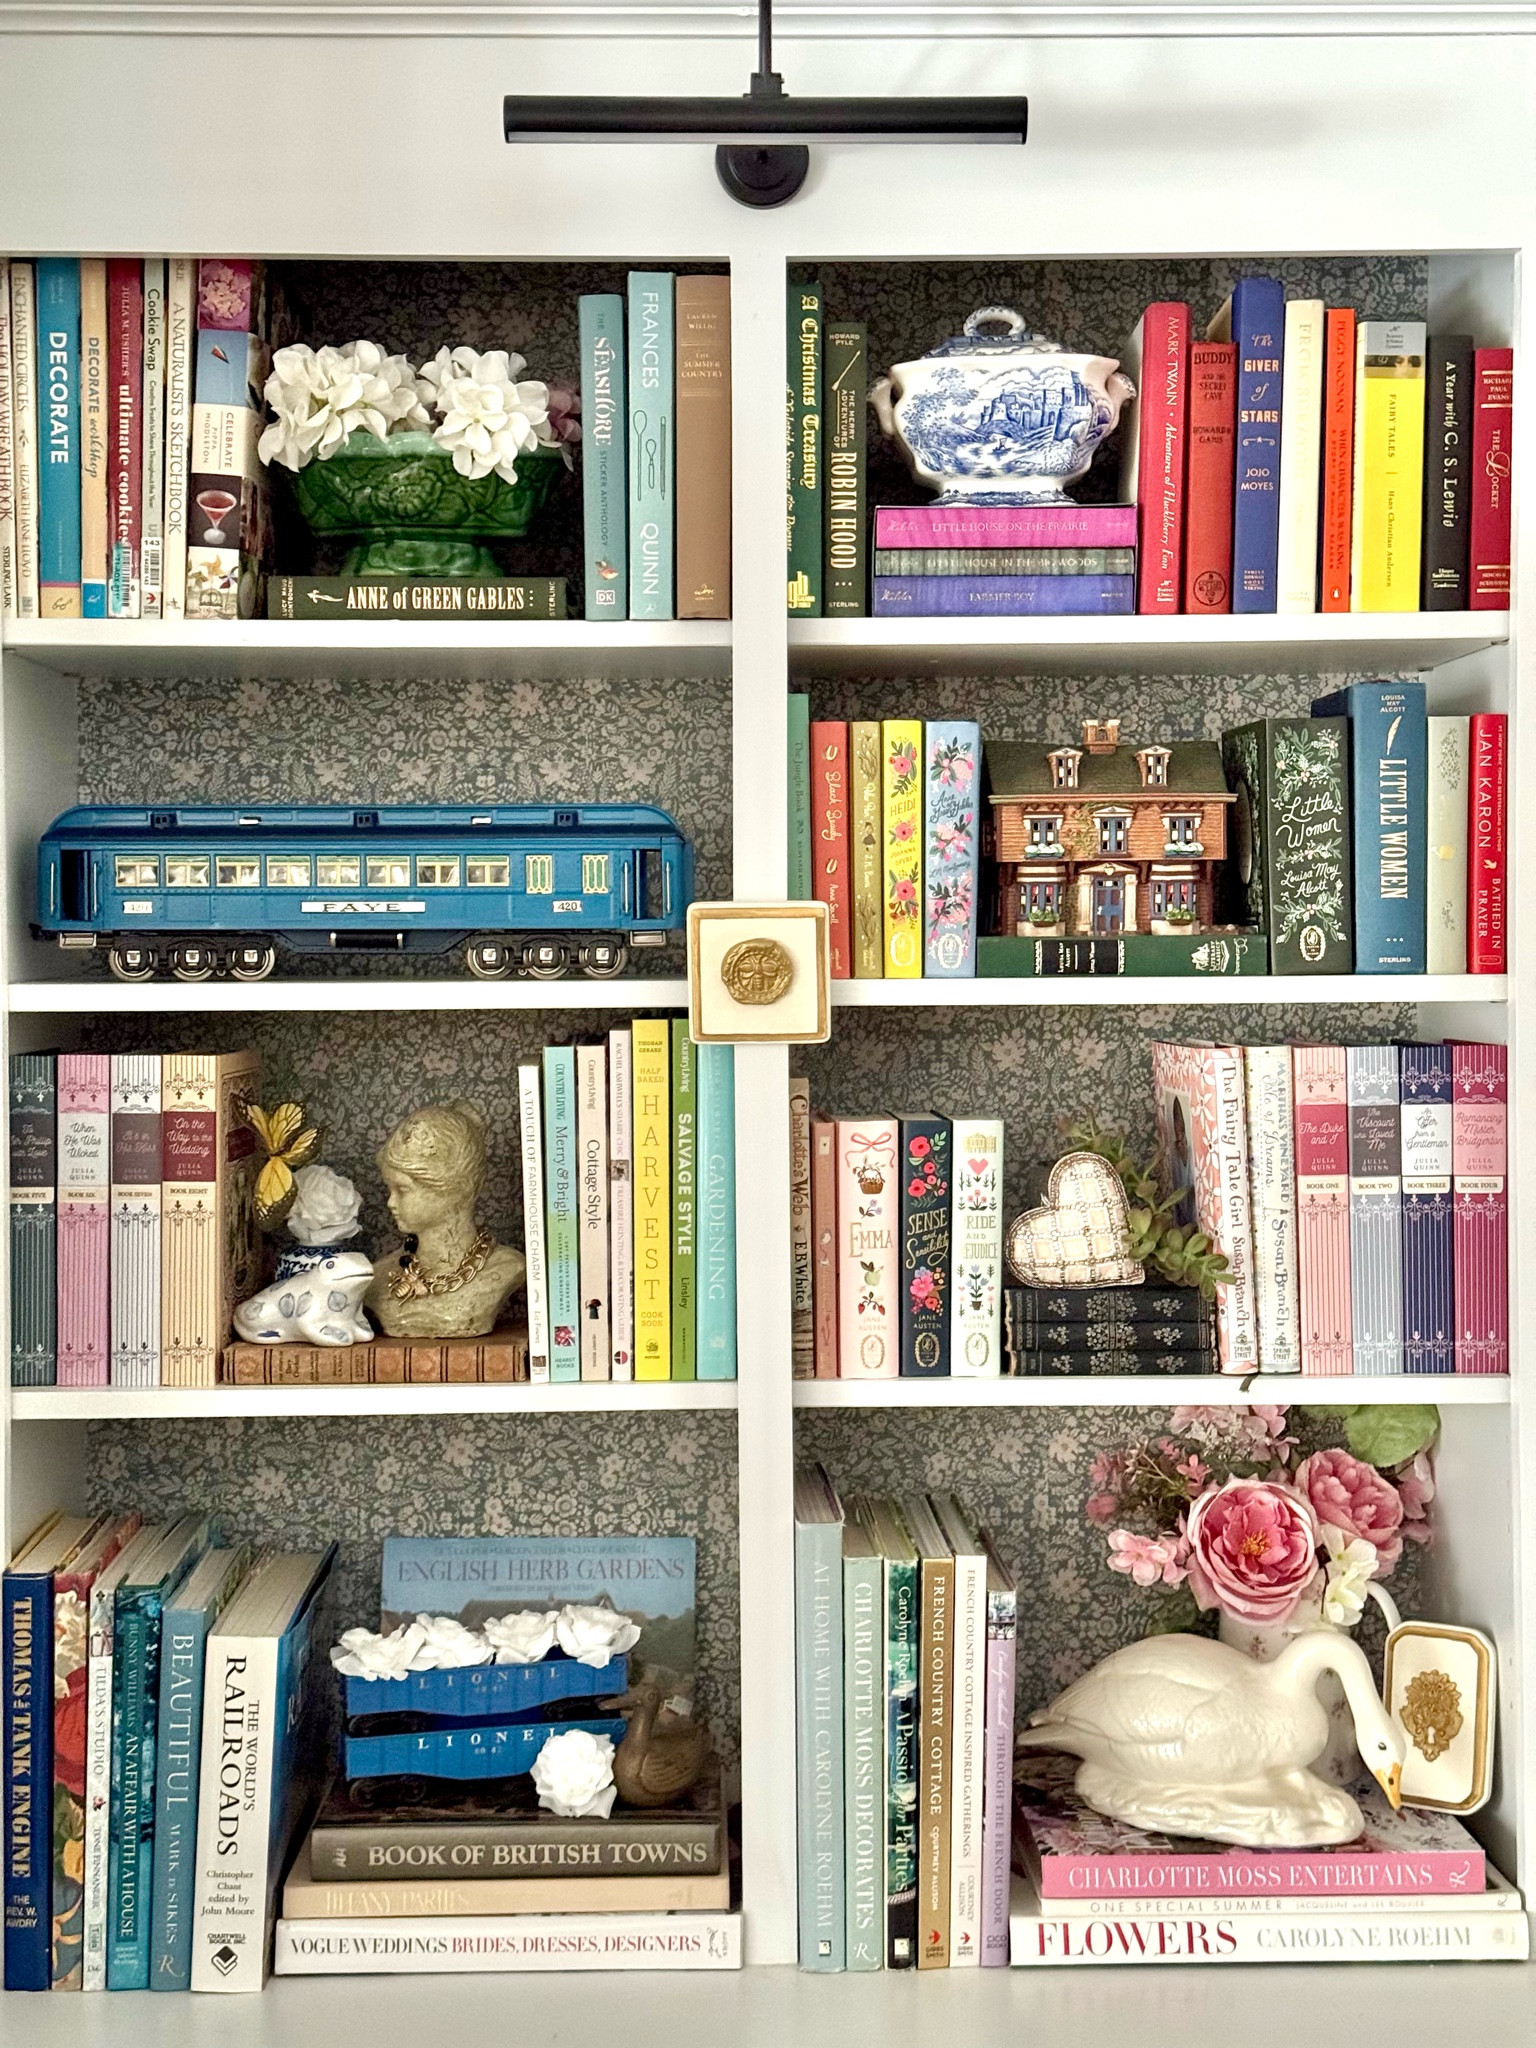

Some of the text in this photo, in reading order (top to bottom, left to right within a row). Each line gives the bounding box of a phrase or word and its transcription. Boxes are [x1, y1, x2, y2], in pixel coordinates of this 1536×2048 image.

[14, 277, 29, 412] ENCHANTED CIRCLES
[642, 292, 659, 389] FRANCES
[1167, 317, 1179, 355] MARK
[1194, 353, 1234, 365] BUDDY
[1166, 360, 1178, 405] TWAIN
[1244, 360, 1280, 373] GIVER
[50, 332, 69, 463] DECORATE
[85, 337, 104, 478] DECORATE workshop
[118, 286, 134, 546] JULIA M. USHER'S ultimate cookies
[168, 303, 186, 535] A NATURALIST'S SKETCHBOOK
[840, 389, 849, 449] ADVENTURES
[848, 390, 856, 441] THE MERRY
[1241, 410, 1279, 424] STARS
[1388, 394, 1397, 424] FAIRY
[223, 412, 235, 469] CELEBRATE
[1163, 422, 1177, 473] Adventures
[1388, 427, 1396, 459] TALES
[1442, 360, 1459, 528] A Year with C. S. Lewis
[1163, 475, 1176, 488] of
[1241, 481, 1274, 491] MOYES
[1245, 468, 1270, 478] JOJO
[1486, 430, 1511, 509] THE LOCKET
[830, 452, 857, 569] ROBIN HOOD
[1160, 490, 1176, 546] Huckleberry
[1387, 512, 1396, 549] Christian
[640, 522, 660, 595] QUINN
[1161, 548, 1173, 570] Finn
[1386, 550, 1395, 588] Andersen
[346, 586, 524, 609] ANNE of GREEN GABLES
[890, 799, 916, 817] HEIDI
[1281, 792, 1335, 823] Little
[1478, 729, 1493, 848] JAN KARON
[1275, 818, 1342, 848] Women
[1379, 758, 1408, 899] LITTLE WOMEN
[322, 901, 402, 912] FAYE
[557, 902, 578, 911] 420
[1478, 890, 1489, 938] PRAYER
[1491, 878, 1502, 949] BATHED IN
[167, 1130, 213, 1142] Way to the
[174, 1117, 206, 1129] On the
[1277, 1061, 1291, 1203] MARTHA'S VINEYARD
[169, 1144, 210, 1158] Wedding
[678, 1113, 692, 1195] SALVAGE
[642, 1094, 660, 1300] HARVEST
[1221, 1061, 1251, 1328] The Fairy Tale Girl Susan Branch
[678, 1202, 692, 1255] STYLE
[708, 1154, 726, 1300] GARDENING
[848, 1221, 894, 1258] EMMA
[907, 1207, 949, 1236] SENSE
[922, 1228, 937, 1240] and
[1272, 1219, 1288, 1269] Susan
[905, 1231, 950, 1270] Sensibility
[680, 1277, 691, 1309] Linsley
[918, 1313, 937, 1322] JANE
[1274, 1269, 1291, 1327] Branch
[913, 1322, 943, 1330] AUSTEN
[398, 1558, 685, 1582] ENGLISH HERB GARDENS
[12, 1597, 33, 1697] THOMAS
[128, 1623, 141, 1664] BUNNY
[126, 1669, 139, 1727] WILLIAMS
[419, 1667, 562, 1689] LIONEL
[93, 1667, 108, 1776] TILDA'S STUDIO
[166, 1634, 195, 1810] BEAUTIFUL
[962, 1570, 977, 1858] FRENCH COUNTRY COTTAGE INSPIRED GATHERINGS
[12, 1713, 32, 1777] TANK
[126, 1732, 140, 1755] AN
[216, 1655, 247, 1855] RAILROADS
[244, 1700, 260, 1811] THE WORLD'S
[814, 1563, 833, 1927] AT HOME WITH CAROLYNE ROEHM
[854, 1583, 874, 1929] CHARLOTTE MOSS DECORATES
[930, 1576, 946, 1910] FRENCH COUNTRY COTTAGE COURTNEY ALLISON
[995, 1735, 1008, 1799] THROUGH
[124, 1759, 140, 1815] AFFAIR
[12, 1785, 31, 1877] ENGINE
[995, 1805, 1006, 1829] THE
[122, 1820, 137, 1864] WITH
[168, 1823, 182, 1872] MARK
[368, 1842, 708, 1866] BOOK OF BRITISH TOWNS
[994, 1833, 1006, 1884] FRENCH
[122, 1868, 136, 1880] A
[1069, 1863, 1433, 1889] CHARLOTTE MOSS ENTERTAINS
[120, 1882, 136, 1937] HOUSE
[166, 1893, 181, 1944] SIKES
[993, 1888, 1004, 1925] DOOR
[291, 1937, 351, 1954] VOGUE
[354, 1937, 448, 1954] WEDDINGS
[452, 1937, 520, 1955] BRIDES,
[522, 1936, 602, 1955] DRESSES,
[604, 1936, 702, 1953] DESIGNERS
[1036, 1920, 1238, 1957] FLOWERS
[1257, 1927, 1382, 1949] CAROLYNE
[1388, 1926, 1471, 1948] ROEHM
